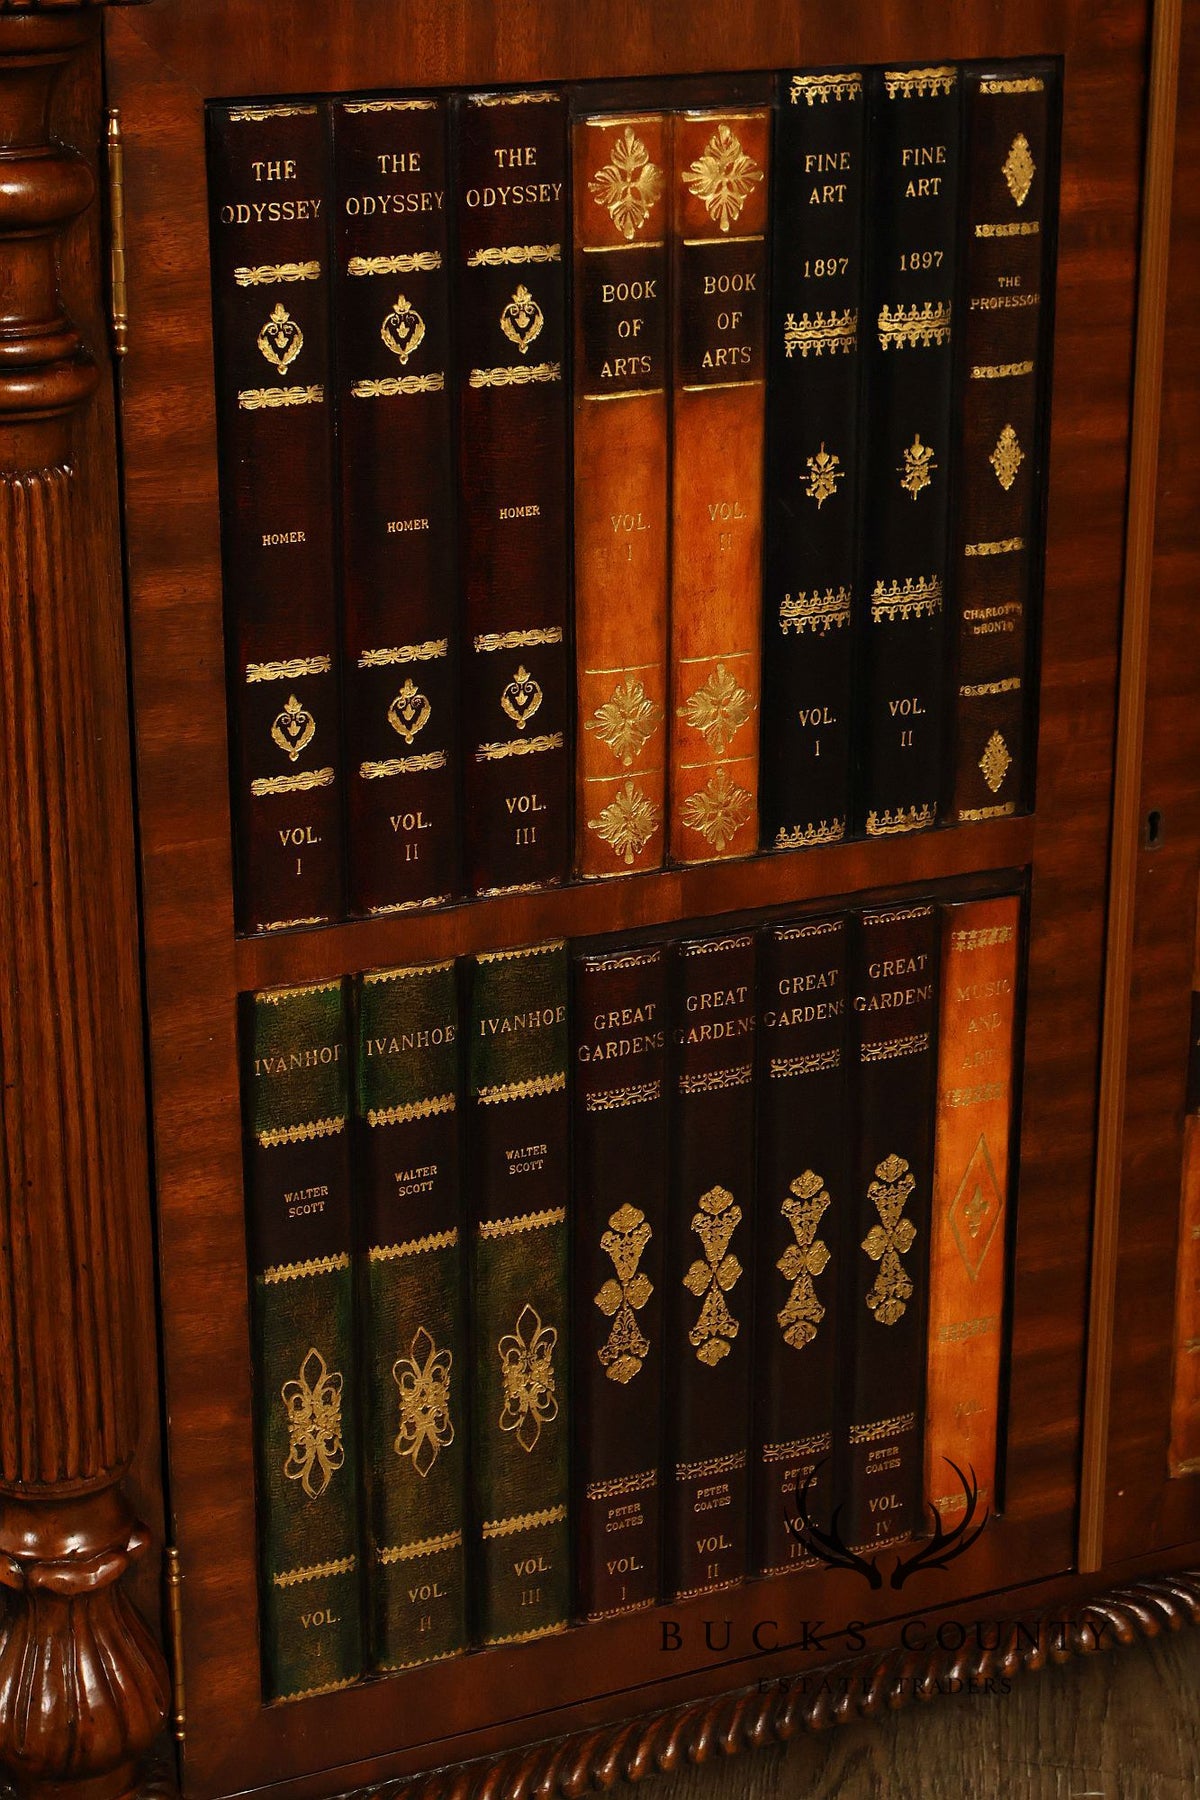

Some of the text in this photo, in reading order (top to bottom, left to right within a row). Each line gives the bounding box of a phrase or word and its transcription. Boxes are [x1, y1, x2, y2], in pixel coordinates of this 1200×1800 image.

[377, 152, 422, 174] THE
[494, 146, 538, 168] THE
[804, 151, 851, 173] FINE
[901, 146, 947, 167] FINE
[251, 159, 297, 182] THE
[466, 183, 563, 209] ODYSSEY
[808, 184, 847, 205] ART
[904, 177, 942, 198] ART
[220, 199, 322, 225] ODYSSEY
[345, 191, 445, 217] ODYSSEY
[803, 258, 849, 278] 1897
[899, 251, 944, 272] 1897
[601, 280, 657, 303] BOOK
[703, 273, 756, 295] BOOK
[997, 275, 1022, 288] THE
[617, 318, 644, 338] OF
[717, 311, 743, 330] OF
[600, 355, 652, 378] ARTS
[701, 346, 752, 368] ARTS
[498, 504, 542, 520] HOMER
[708, 501, 747, 521] VOL.
[387, 518, 430, 533] HOMER
[610, 512, 651, 533] VOL.
[261, 530, 306, 547] HOMER
[799, 706, 837, 727] VOL.
[888, 697, 926, 717] VOL.
[814, 740, 820, 757] I
[900, 730, 913, 747] II
[505, 794, 547, 814] VOL.
[389, 811, 432, 833] VOL.
[278, 825, 322, 846] VOL.
[515, 826, 537, 845] III
[405, 843, 419, 861] II
[296, 858, 302, 875] I
[868, 953, 928, 979] GREAT
[778, 969, 839, 996] GREAT
[686, 986, 748, 1013] GREAT
[480, 1005, 567, 1036] IVANHOE
[594, 1003, 657, 1031] GREAT
[366, 1025, 456, 1057] IVANHOE
[578, 1031, 665, 1062] GARDENS
[505, 1143, 548, 1161] WALTER
[394, 1164, 438, 1183] WALTER
[509, 1159, 544, 1175] SCOTT
[283, 1185, 329, 1203] WALTER
[398, 1180, 435, 1198] SCOTT
[288, 1201, 325, 1218] SCOTT
[868, 1446, 899, 1462] PETER
[784, 1465, 816, 1480] PEER
[865, 1458, 901, 1475] COATES
[696, 1483, 730, 1499] PETER
[781, 1477, 817, 1493] COTS
[607, 1502, 641, 1519] PETER
[693, 1496, 732, 1513] COATES
[868, 1494, 903, 1513] VOL.
[605, 1515, 644, 1533] COATES
[696, 1534, 733, 1554] VOL.
[513, 1556, 552, 1577] VOL.
[606, 1556, 644, 1575] VOL.
[707, 1563, 719, 1579] II
[408, 1582, 447, 1603] VOL.
[520, 1588, 541, 1606] III
[300, 1608, 341, 1629] VOL.
